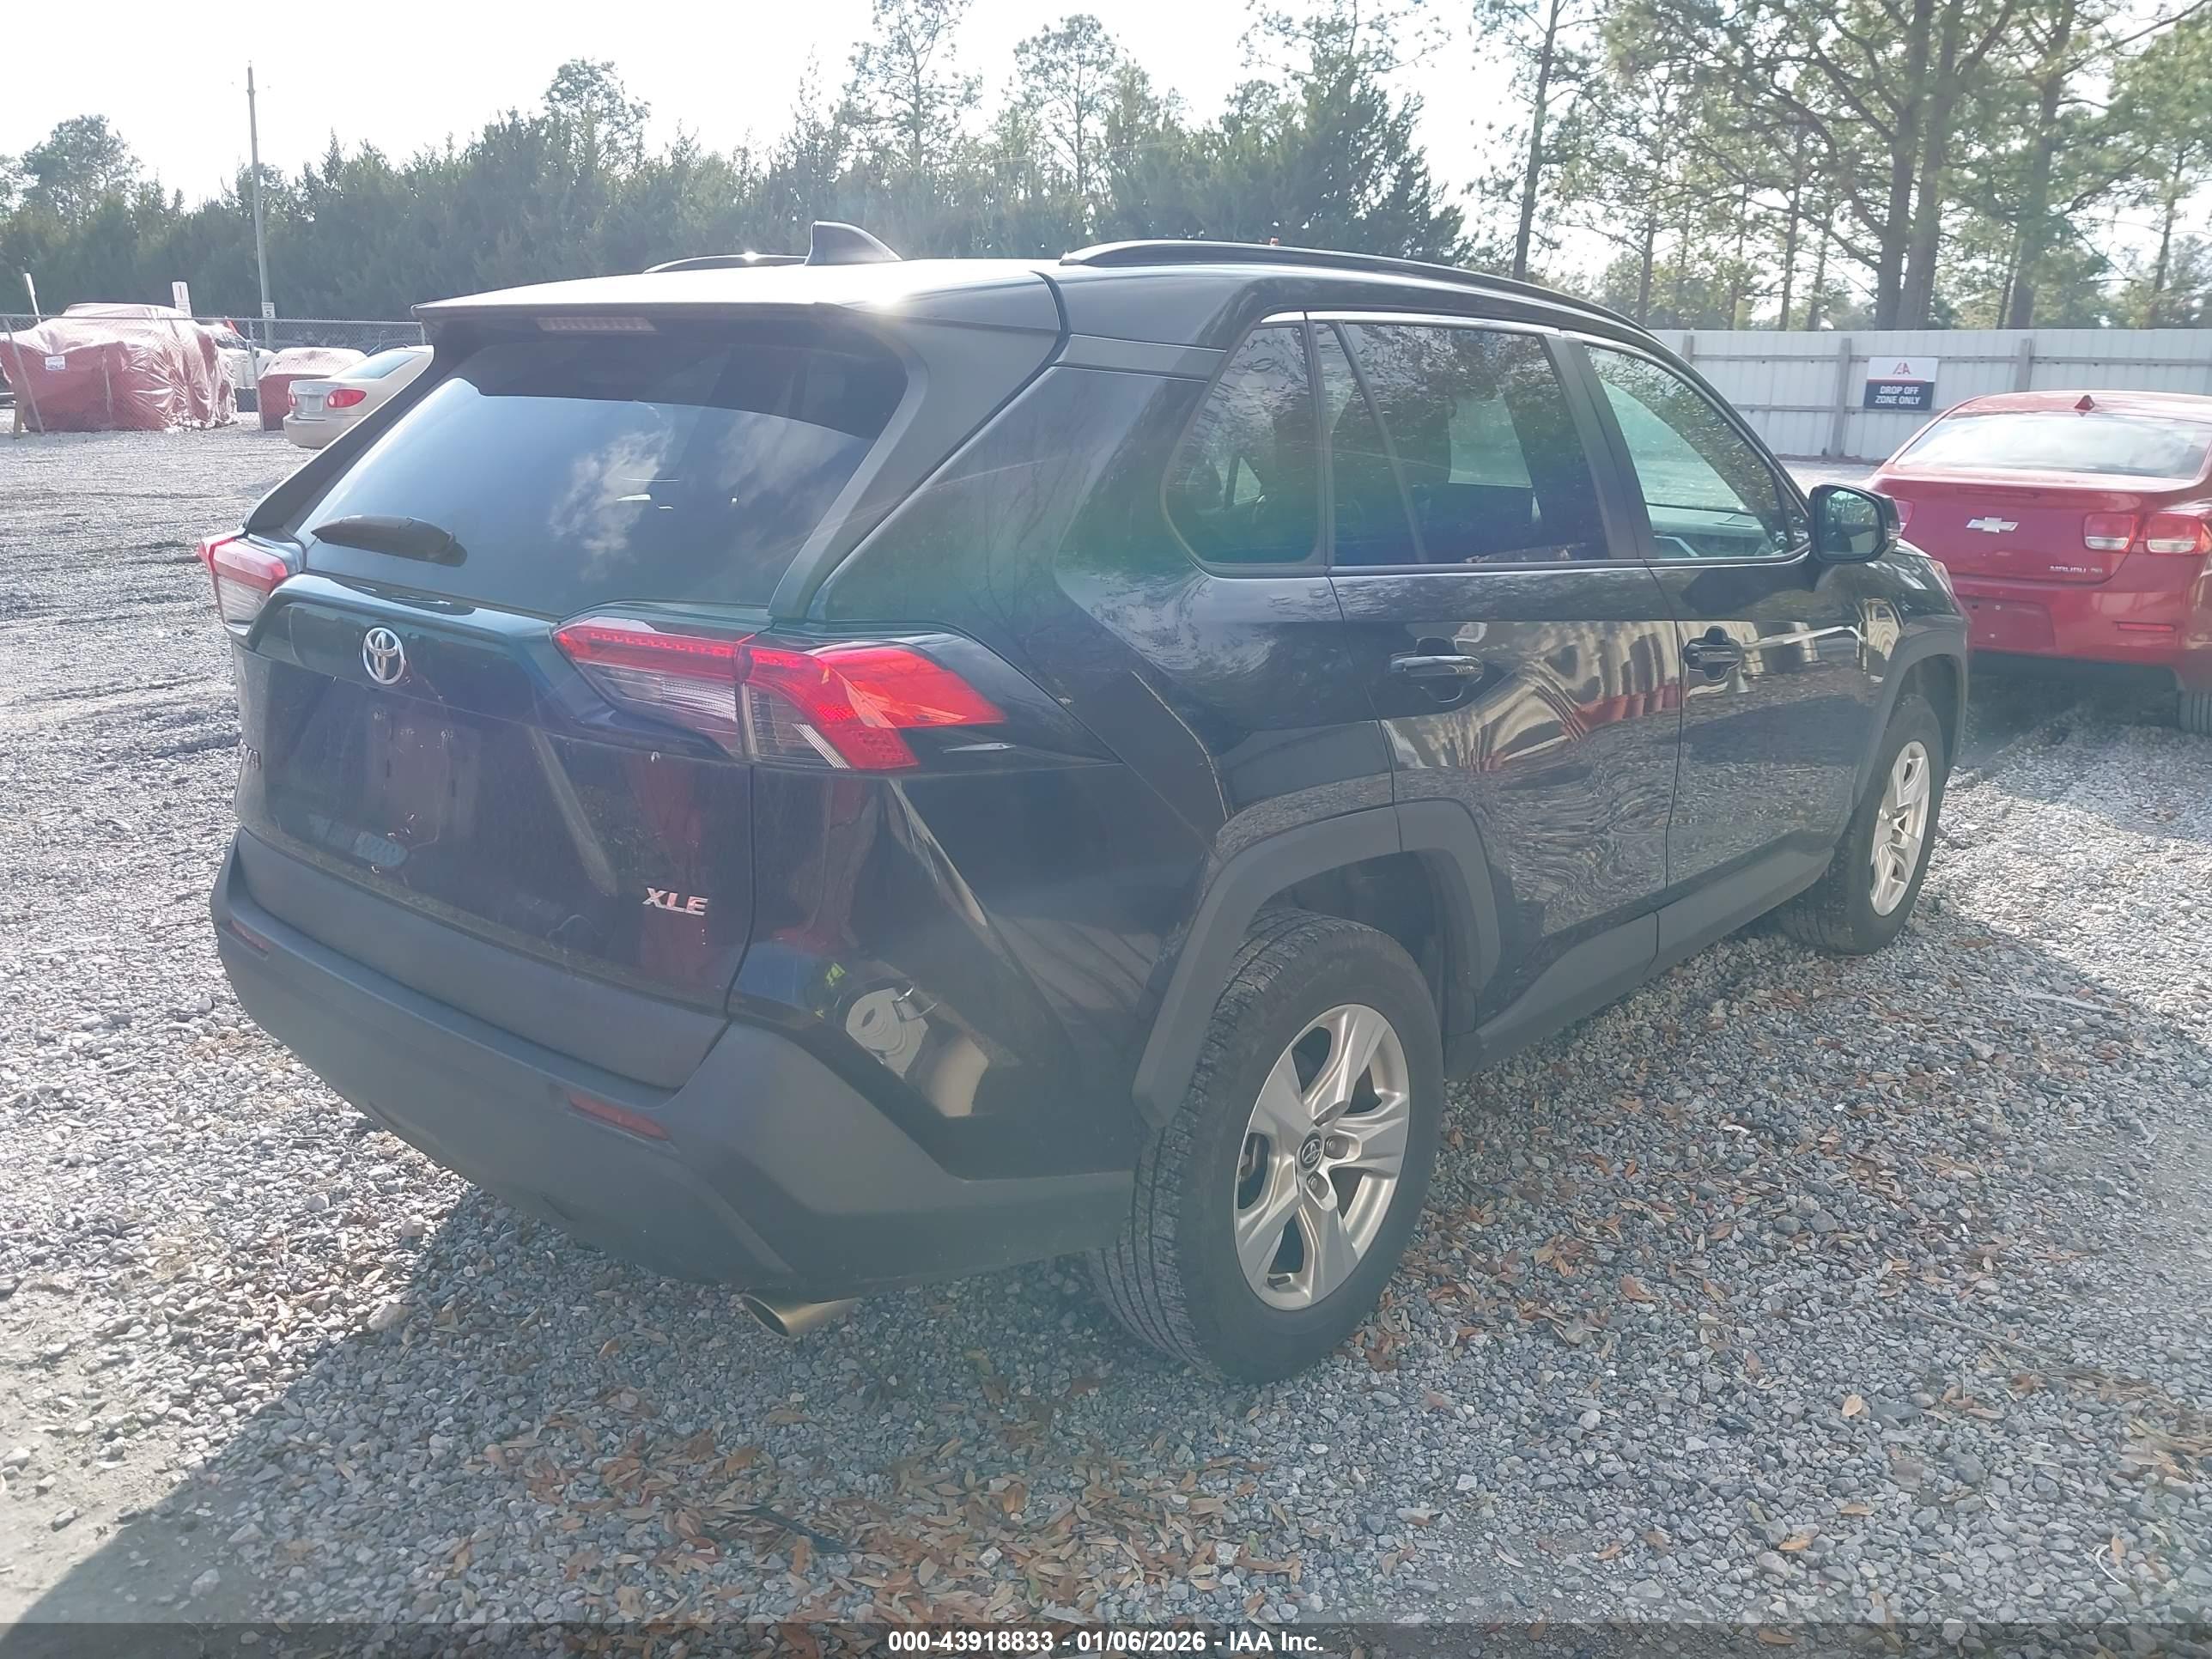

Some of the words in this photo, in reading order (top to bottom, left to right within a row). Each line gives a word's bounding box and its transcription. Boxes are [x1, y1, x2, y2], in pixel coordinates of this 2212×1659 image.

[1880, 386, 1903, 394] DROP
[1904, 386, 1919, 395] OFF
[1875, 395, 1898, 404] ZONE
[1899, 396, 1921, 404] ONLY
[642, 887, 708, 916] XLE
